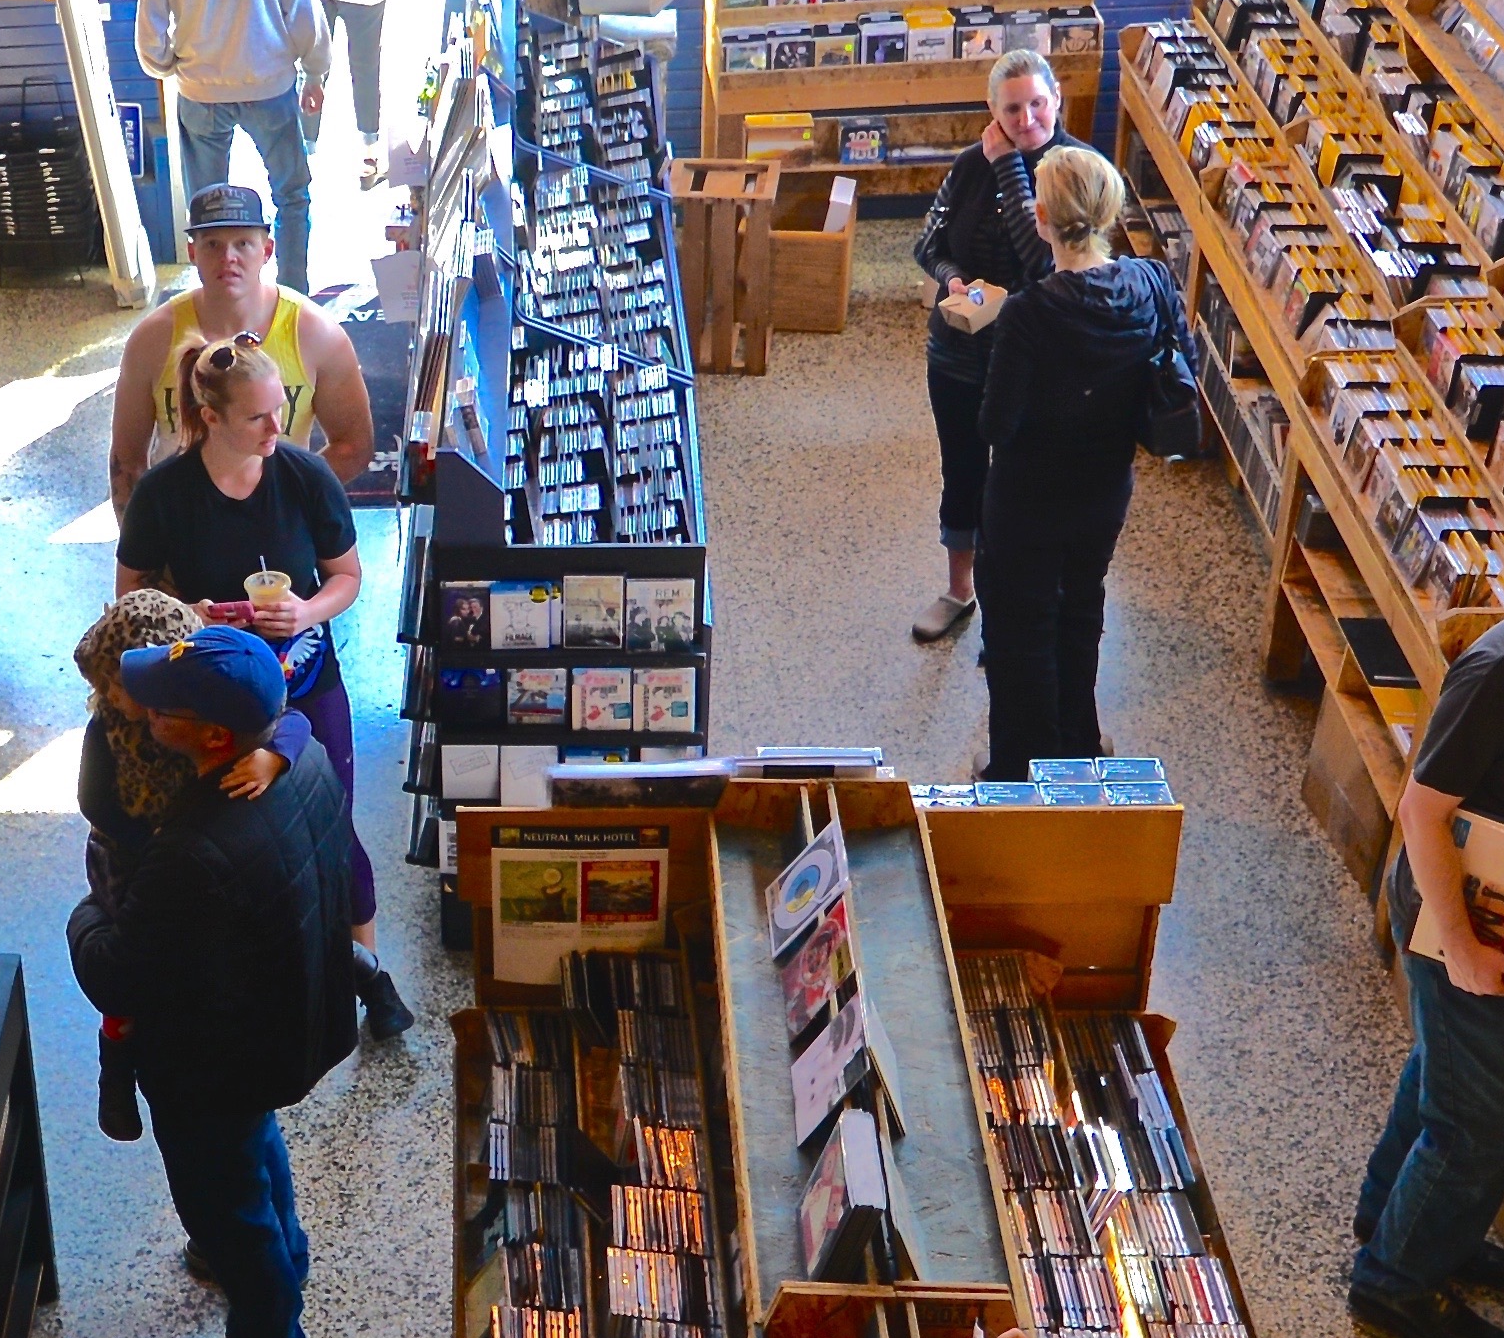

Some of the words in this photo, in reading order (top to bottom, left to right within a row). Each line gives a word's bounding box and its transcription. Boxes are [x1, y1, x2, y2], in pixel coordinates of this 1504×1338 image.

[523, 832, 570, 841] NEUTRAL
[573, 832, 601, 841] MILK
[603, 831, 638, 841] HOTEL
